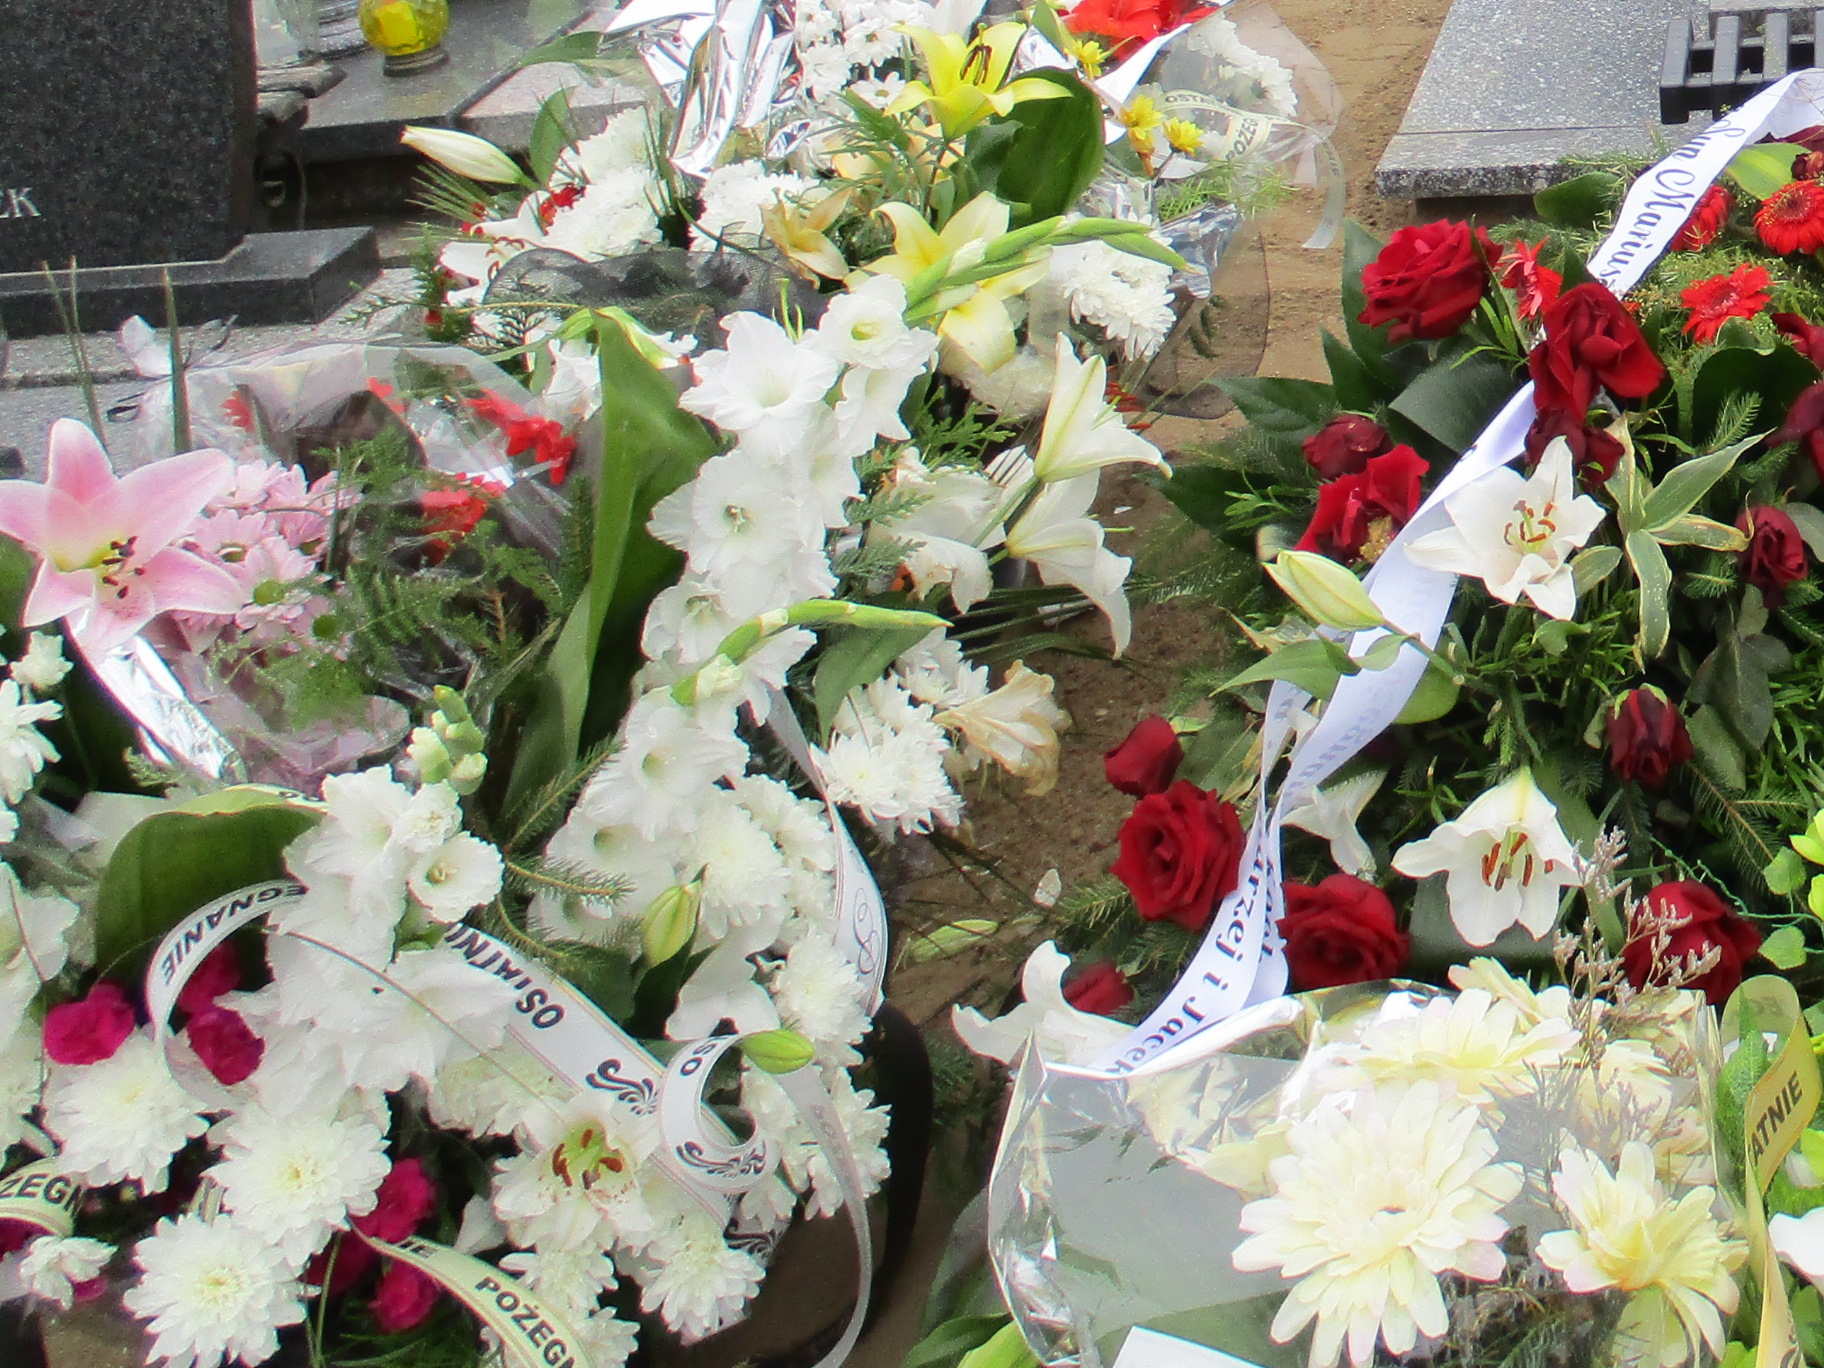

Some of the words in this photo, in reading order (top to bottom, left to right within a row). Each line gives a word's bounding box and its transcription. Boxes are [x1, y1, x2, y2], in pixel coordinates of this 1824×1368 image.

[1224, 117, 1260, 162] POŻEG
[160, 882, 309, 986] EGNANIE
[1751, 1069, 1803, 1168] ATNIE
